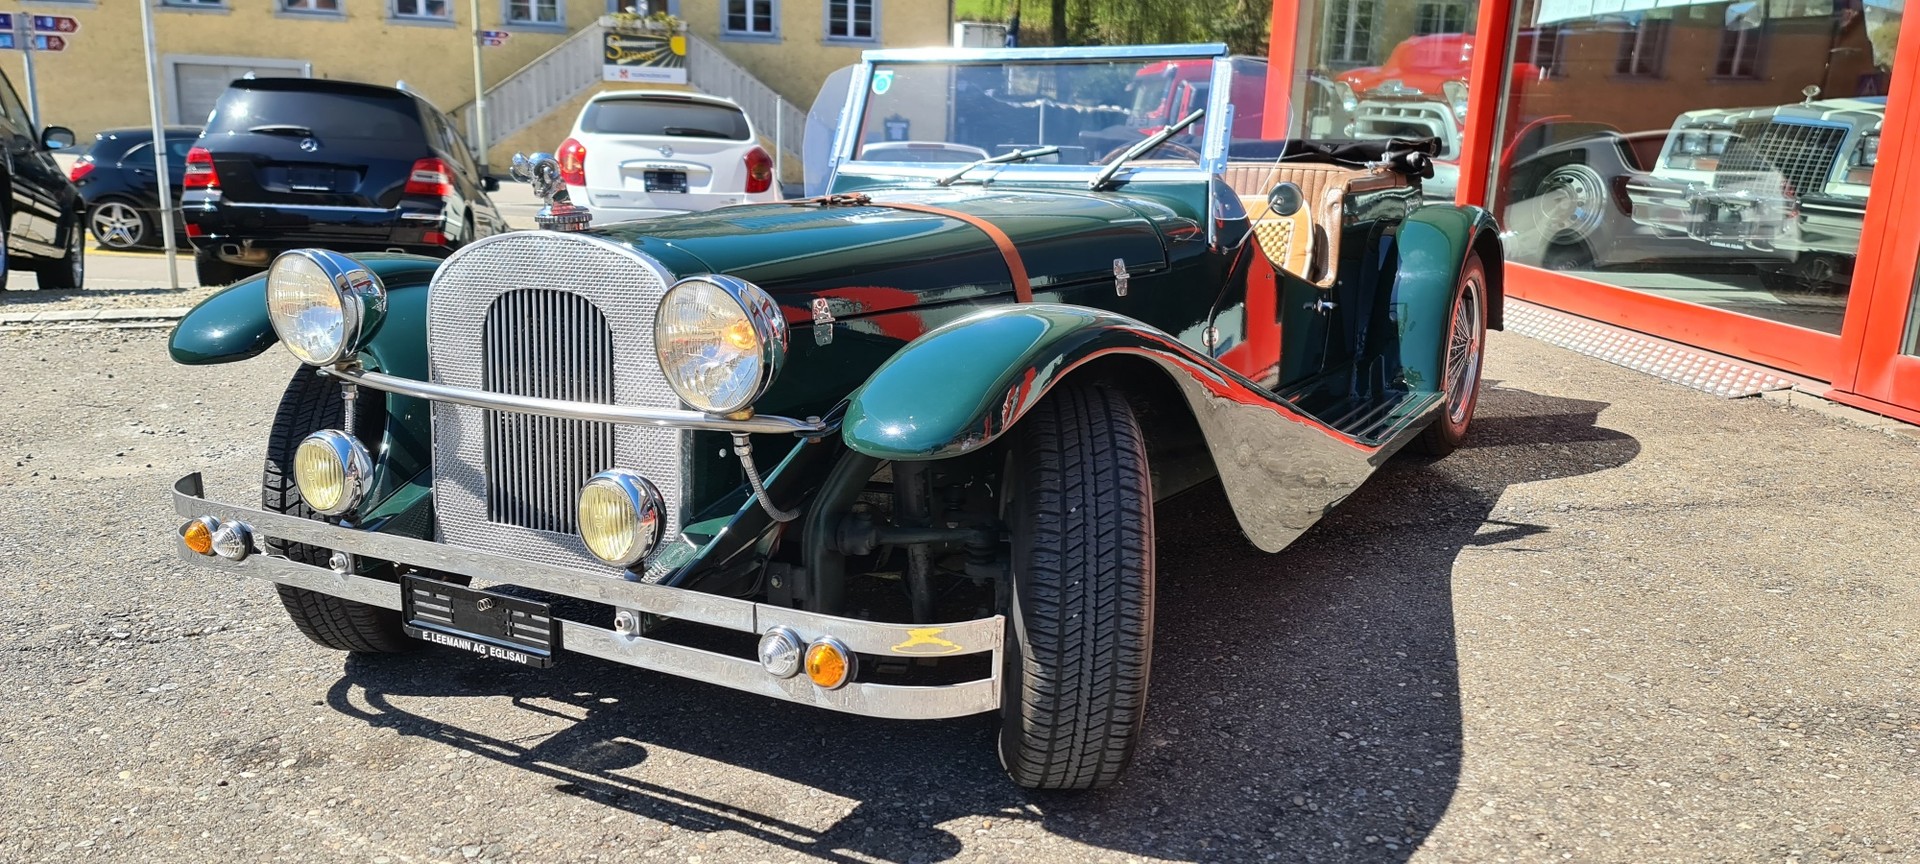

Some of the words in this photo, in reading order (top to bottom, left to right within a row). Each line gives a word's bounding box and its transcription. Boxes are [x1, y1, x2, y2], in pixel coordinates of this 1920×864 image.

[431, 633, 471, 651] LEEMANN
[473, 644, 486, 655] AG
[490, 647, 527, 664] EGLISAU
